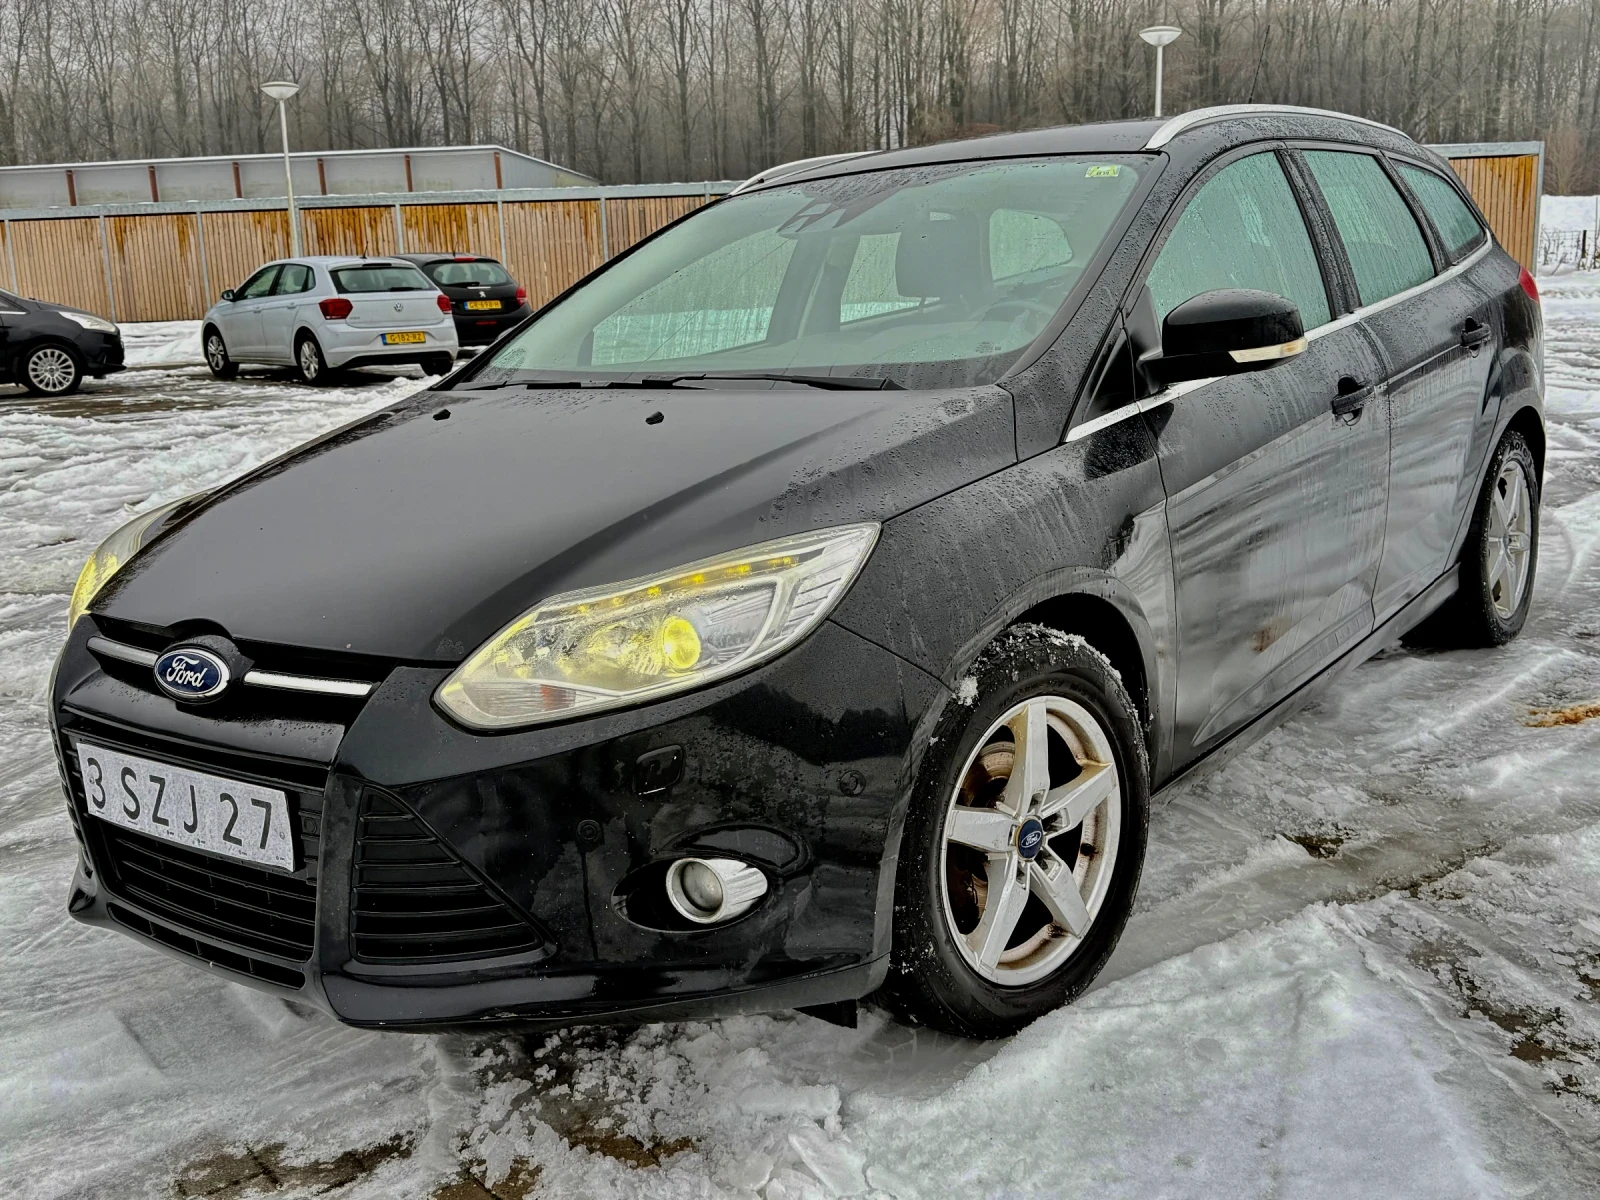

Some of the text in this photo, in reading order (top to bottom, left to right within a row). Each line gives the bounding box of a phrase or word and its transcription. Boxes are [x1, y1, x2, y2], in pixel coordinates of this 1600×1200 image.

[390, 333, 422, 343] G-182-RZ
[166, 655, 208, 688] Ford
[87, 757, 272, 850] 3 SZJ 27
